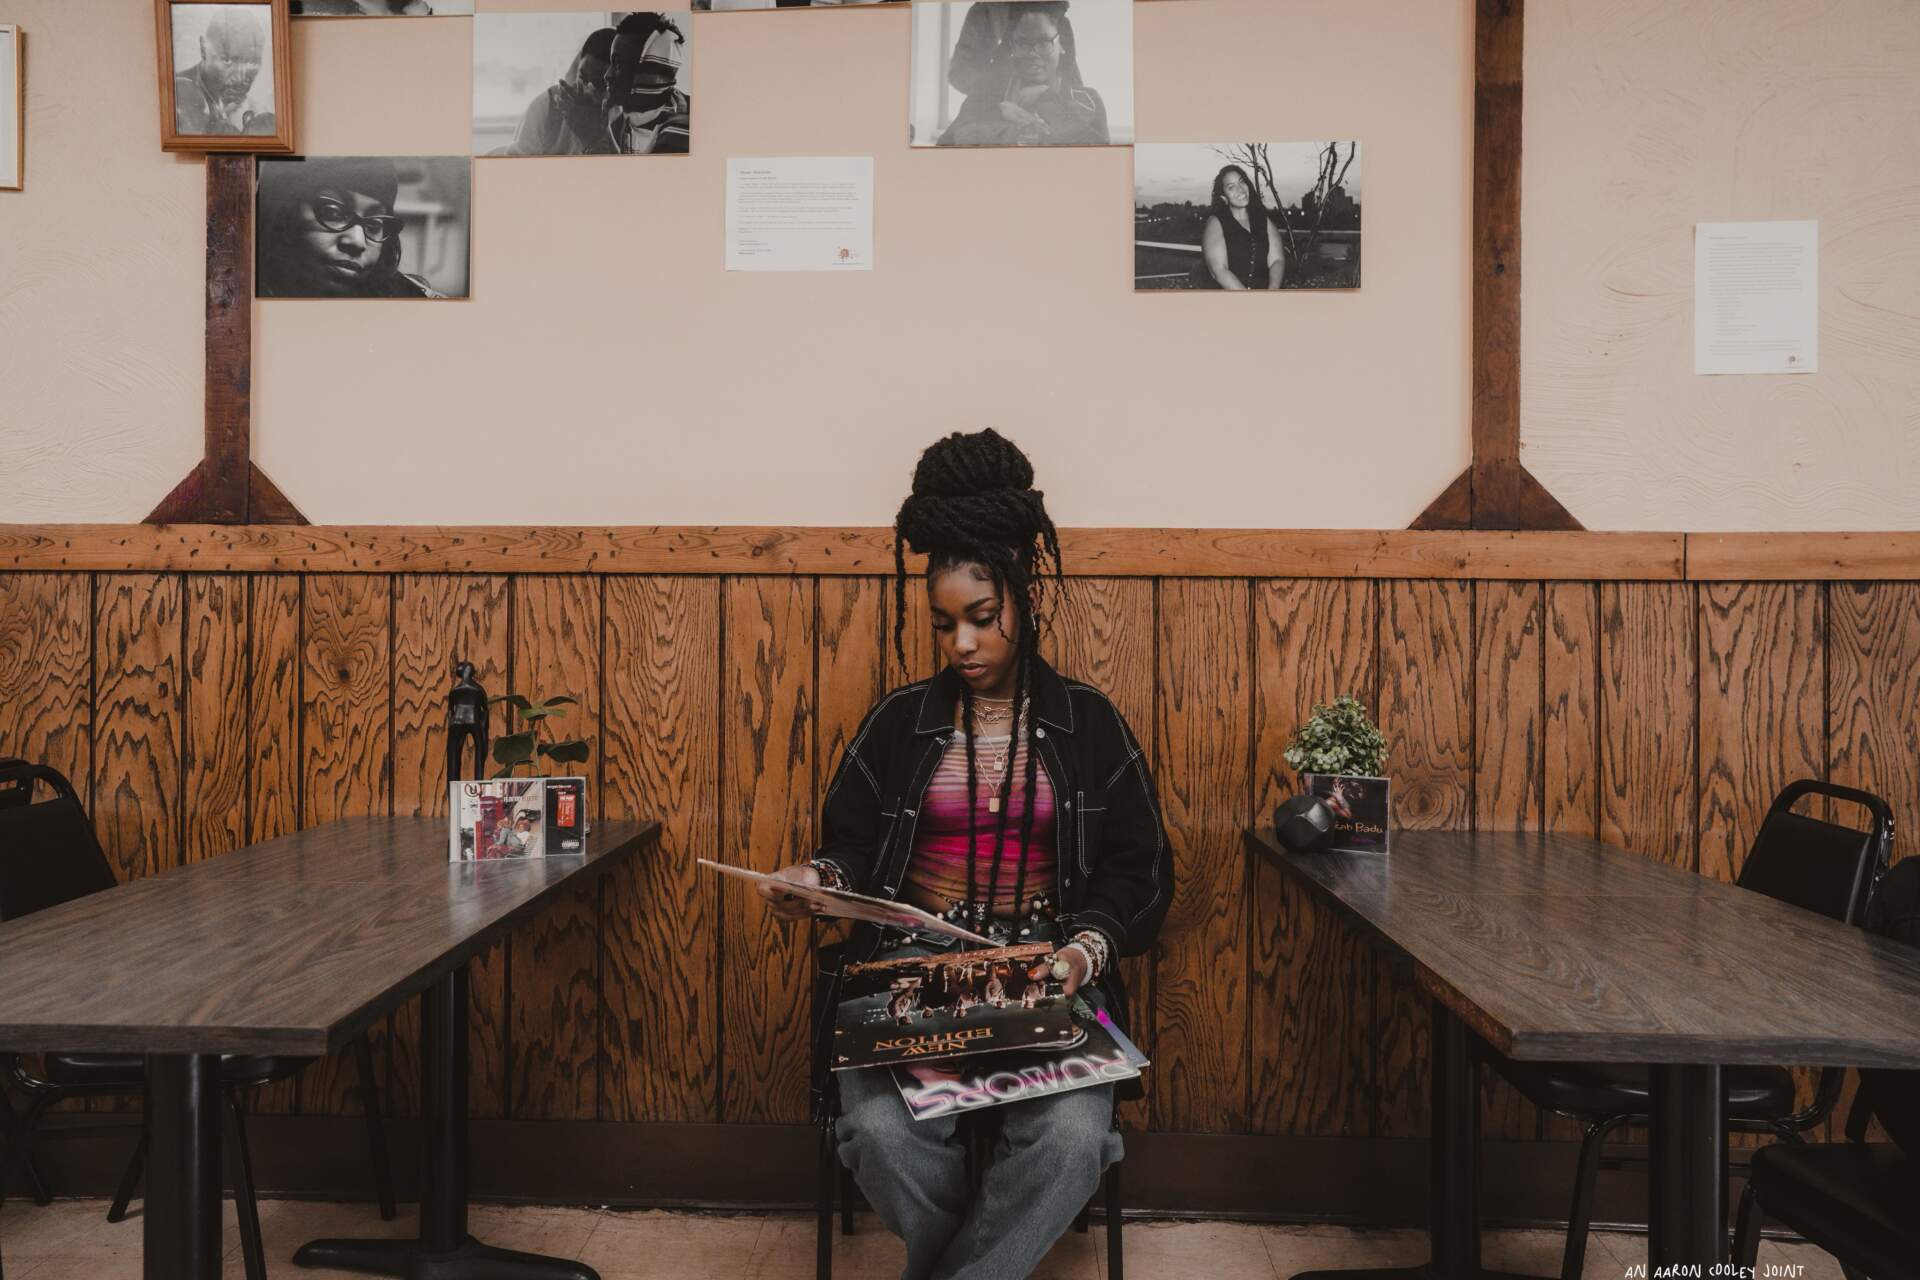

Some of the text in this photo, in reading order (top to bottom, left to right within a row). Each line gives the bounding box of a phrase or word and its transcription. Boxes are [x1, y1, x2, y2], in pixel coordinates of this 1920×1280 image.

[1355, 822, 1383, 833] Badu
[873, 1026, 994, 1051] EDITION
[900, 1039, 968, 1057] NEW
[906, 1048, 1131, 1115] RUMORS
